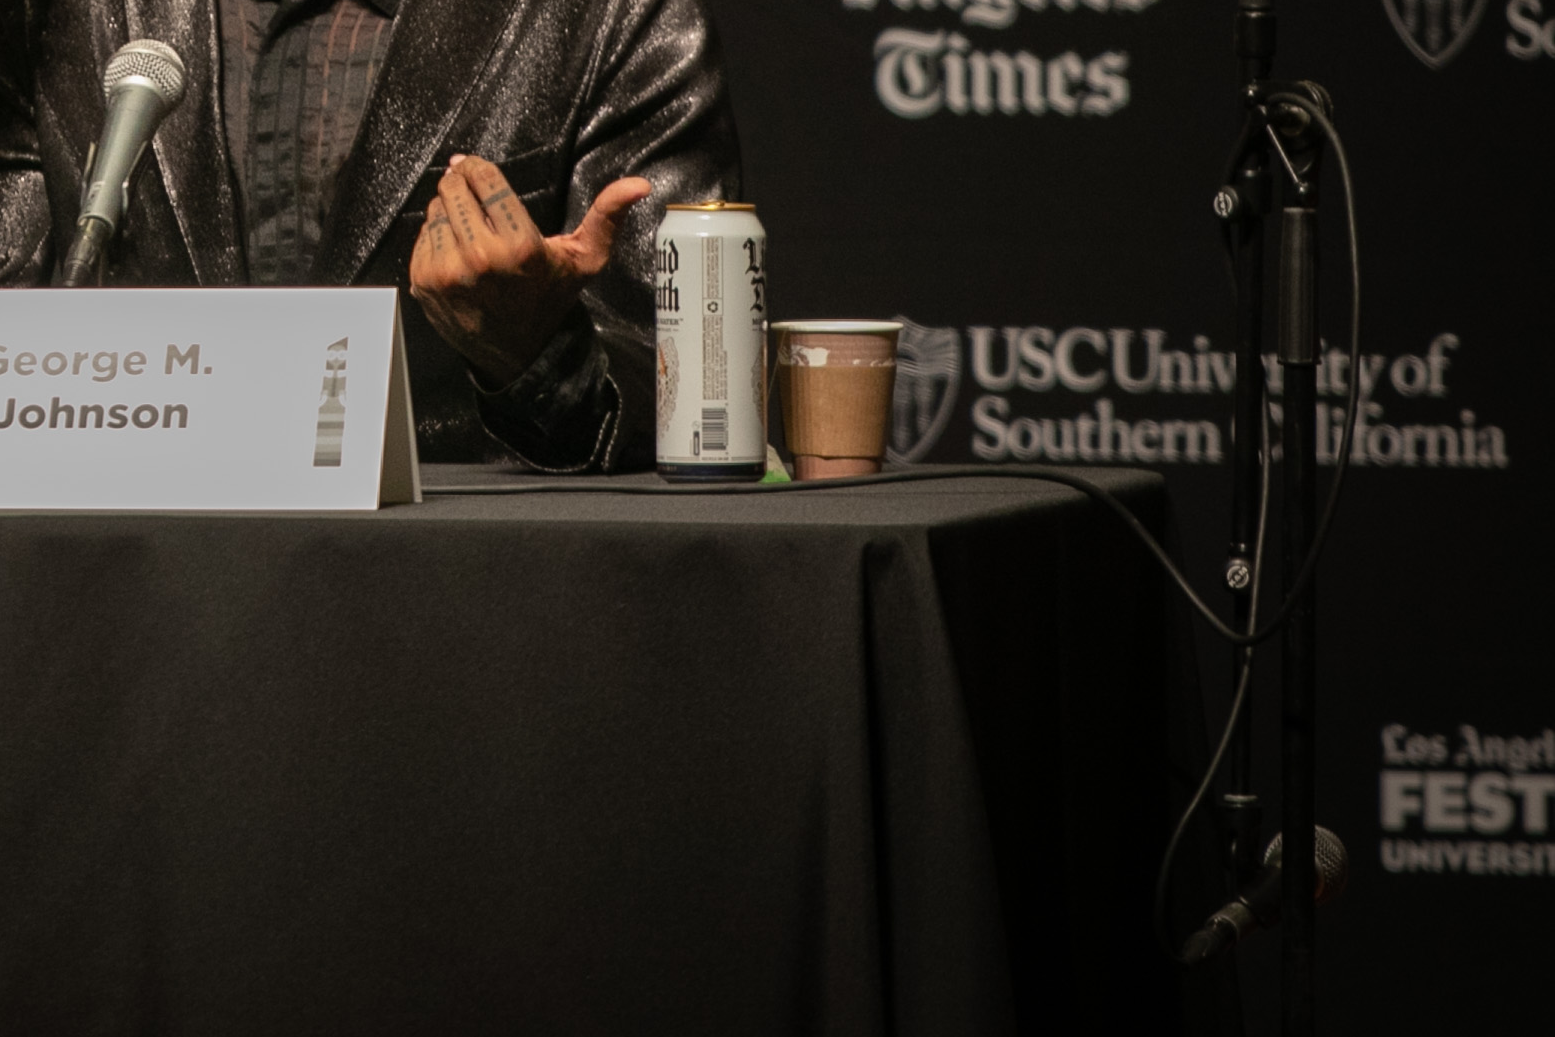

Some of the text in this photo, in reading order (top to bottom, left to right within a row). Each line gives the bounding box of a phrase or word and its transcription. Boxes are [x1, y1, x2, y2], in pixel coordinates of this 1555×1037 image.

[872, 26, 1131, 119] Times
[164, 344, 213, 375] M.
[969, 325, 1108, 391] USC
[1390, 333, 1459, 395] of
[971, 396, 1223, 464] Southern
[1381, 723, 1448, 765] Los
